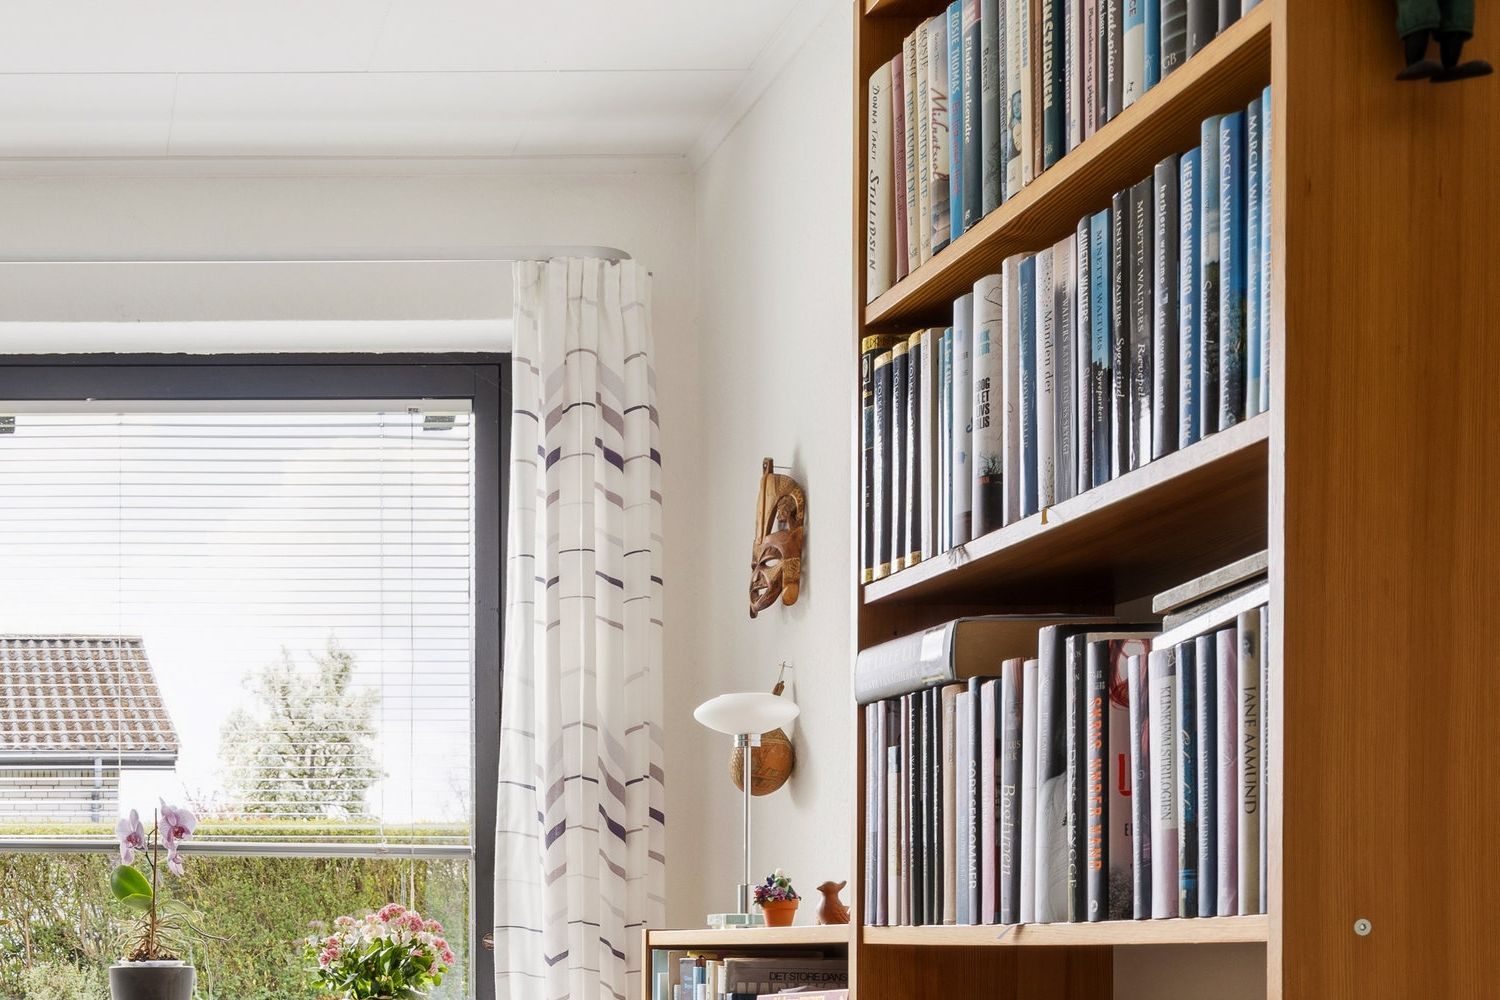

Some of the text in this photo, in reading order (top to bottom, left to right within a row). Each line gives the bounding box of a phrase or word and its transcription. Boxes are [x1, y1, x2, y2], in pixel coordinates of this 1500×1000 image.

[950, 11, 961, 94] ROSIE THOMAS
[964, 35, 973, 145] Elskede ukendte
[871, 85, 881, 125] DONNA
[906, 91, 916, 209] DEN HVIDE DUE
[918, 80, 928, 200] DEN HVIDE DUE
[930, 87, 950, 181] Midnatssol
[1249, 114, 1259, 182] MARCIA
[1220, 128, 1231, 192] MARCIA
[869, 169, 880, 271] STILLIDSEN
[1158, 183, 1168, 236] herbjørg
[1220, 195, 1231, 262] WILLETT
[1061, 297, 1070, 343] WALTERS
[1079, 228, 1089, 324] MINETTE WALTERS
[1113, 209, 1125, 399] MINETTE WALTERS Syge sind
[1134, 201, 1147, 402] MINETTE WALTERS Rævepels
[1159, 310, 1167, 330] det
[1181, 160, 1193, 440] HERBJØRG WASSMO ET GLAS MÆLK TAK
[1043, 309, 1054, 394] Manden der
[1095, 230, 1105, 423] MINETTE WALTERS Syreparken
[1159, 685, 1172, 821] KLINKEVALSTRILOGIEN
[1243, 686, 1257, 815] JANE AAMUND
[1002, 783, 1017, 877] Bogtyven
[1068, 811, 1077, 890] SKYGGE
[1089, 757, 1102, 871] UNDER VAND
[770, 971, 788, 981] DET
[788, 971, 821, 981] STORE
